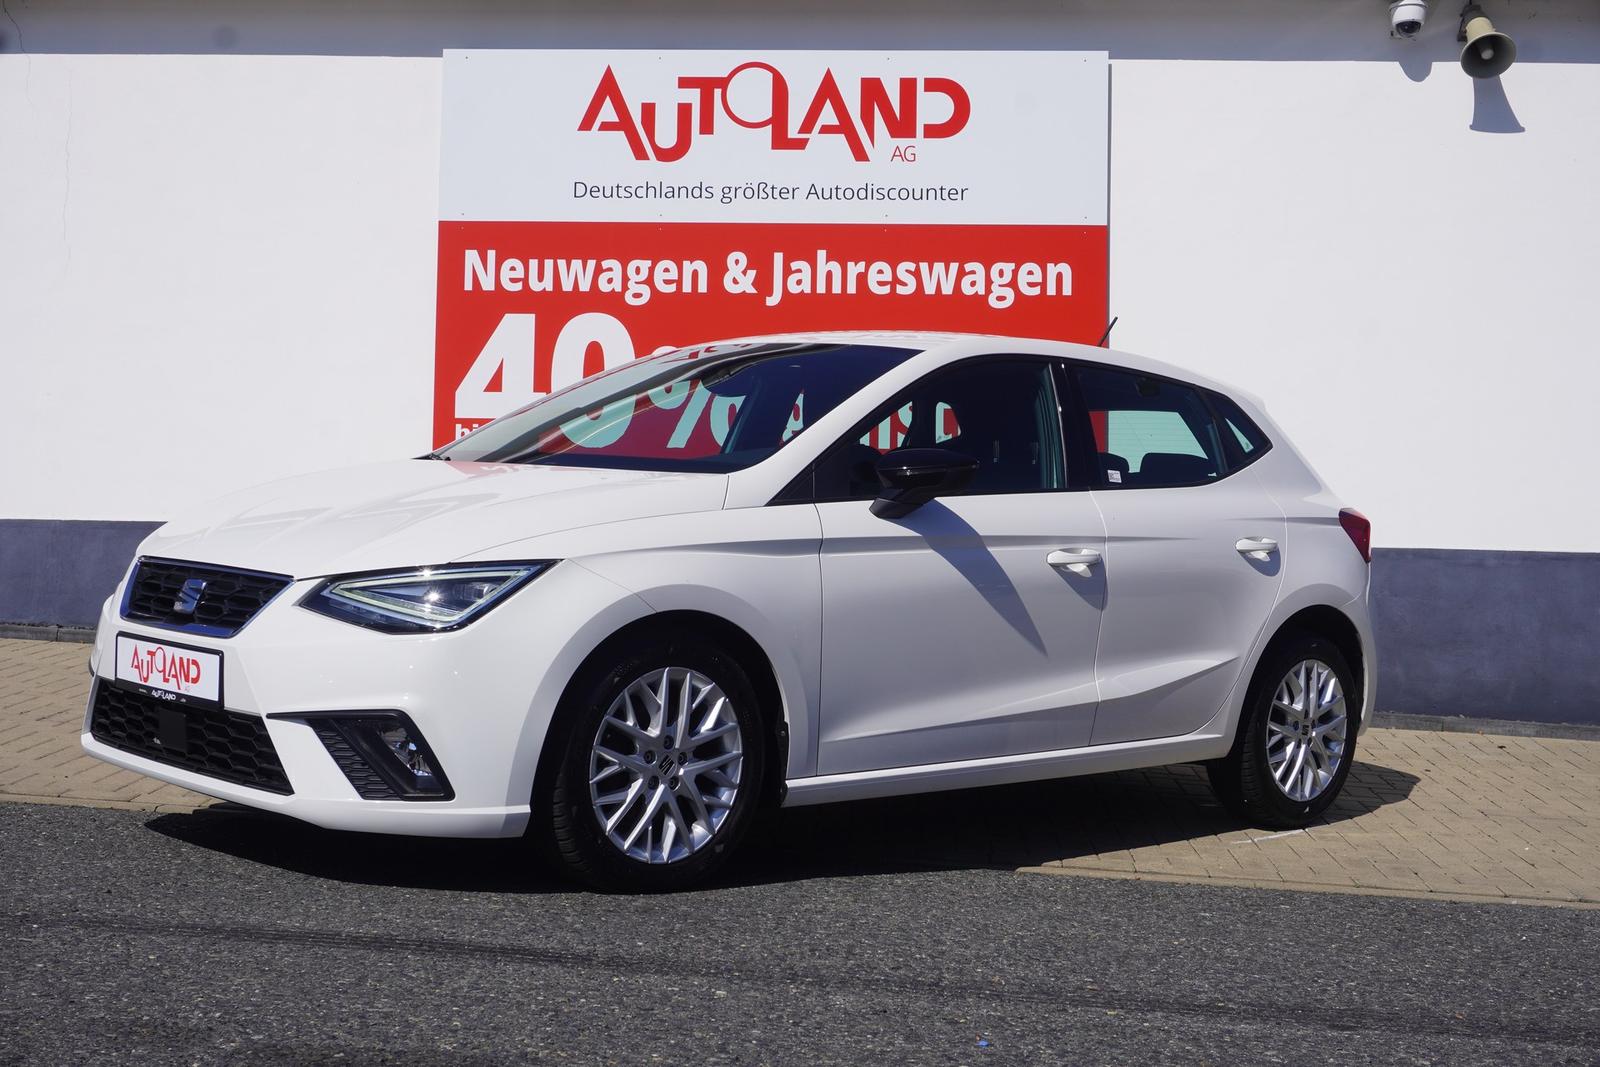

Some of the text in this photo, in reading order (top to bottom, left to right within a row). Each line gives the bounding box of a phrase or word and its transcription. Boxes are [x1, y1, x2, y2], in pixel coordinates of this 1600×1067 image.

[577, 61, 971, 162] AUTOLAND
[891, 146, 917, 163] AG
[573, 181, 969, 204] Deutschlands größter Autodiscounter
[463, 249, 1073, 309] Neuwagen & Jahreswagen
[131, 644, 201, 690] AUTOLAND
